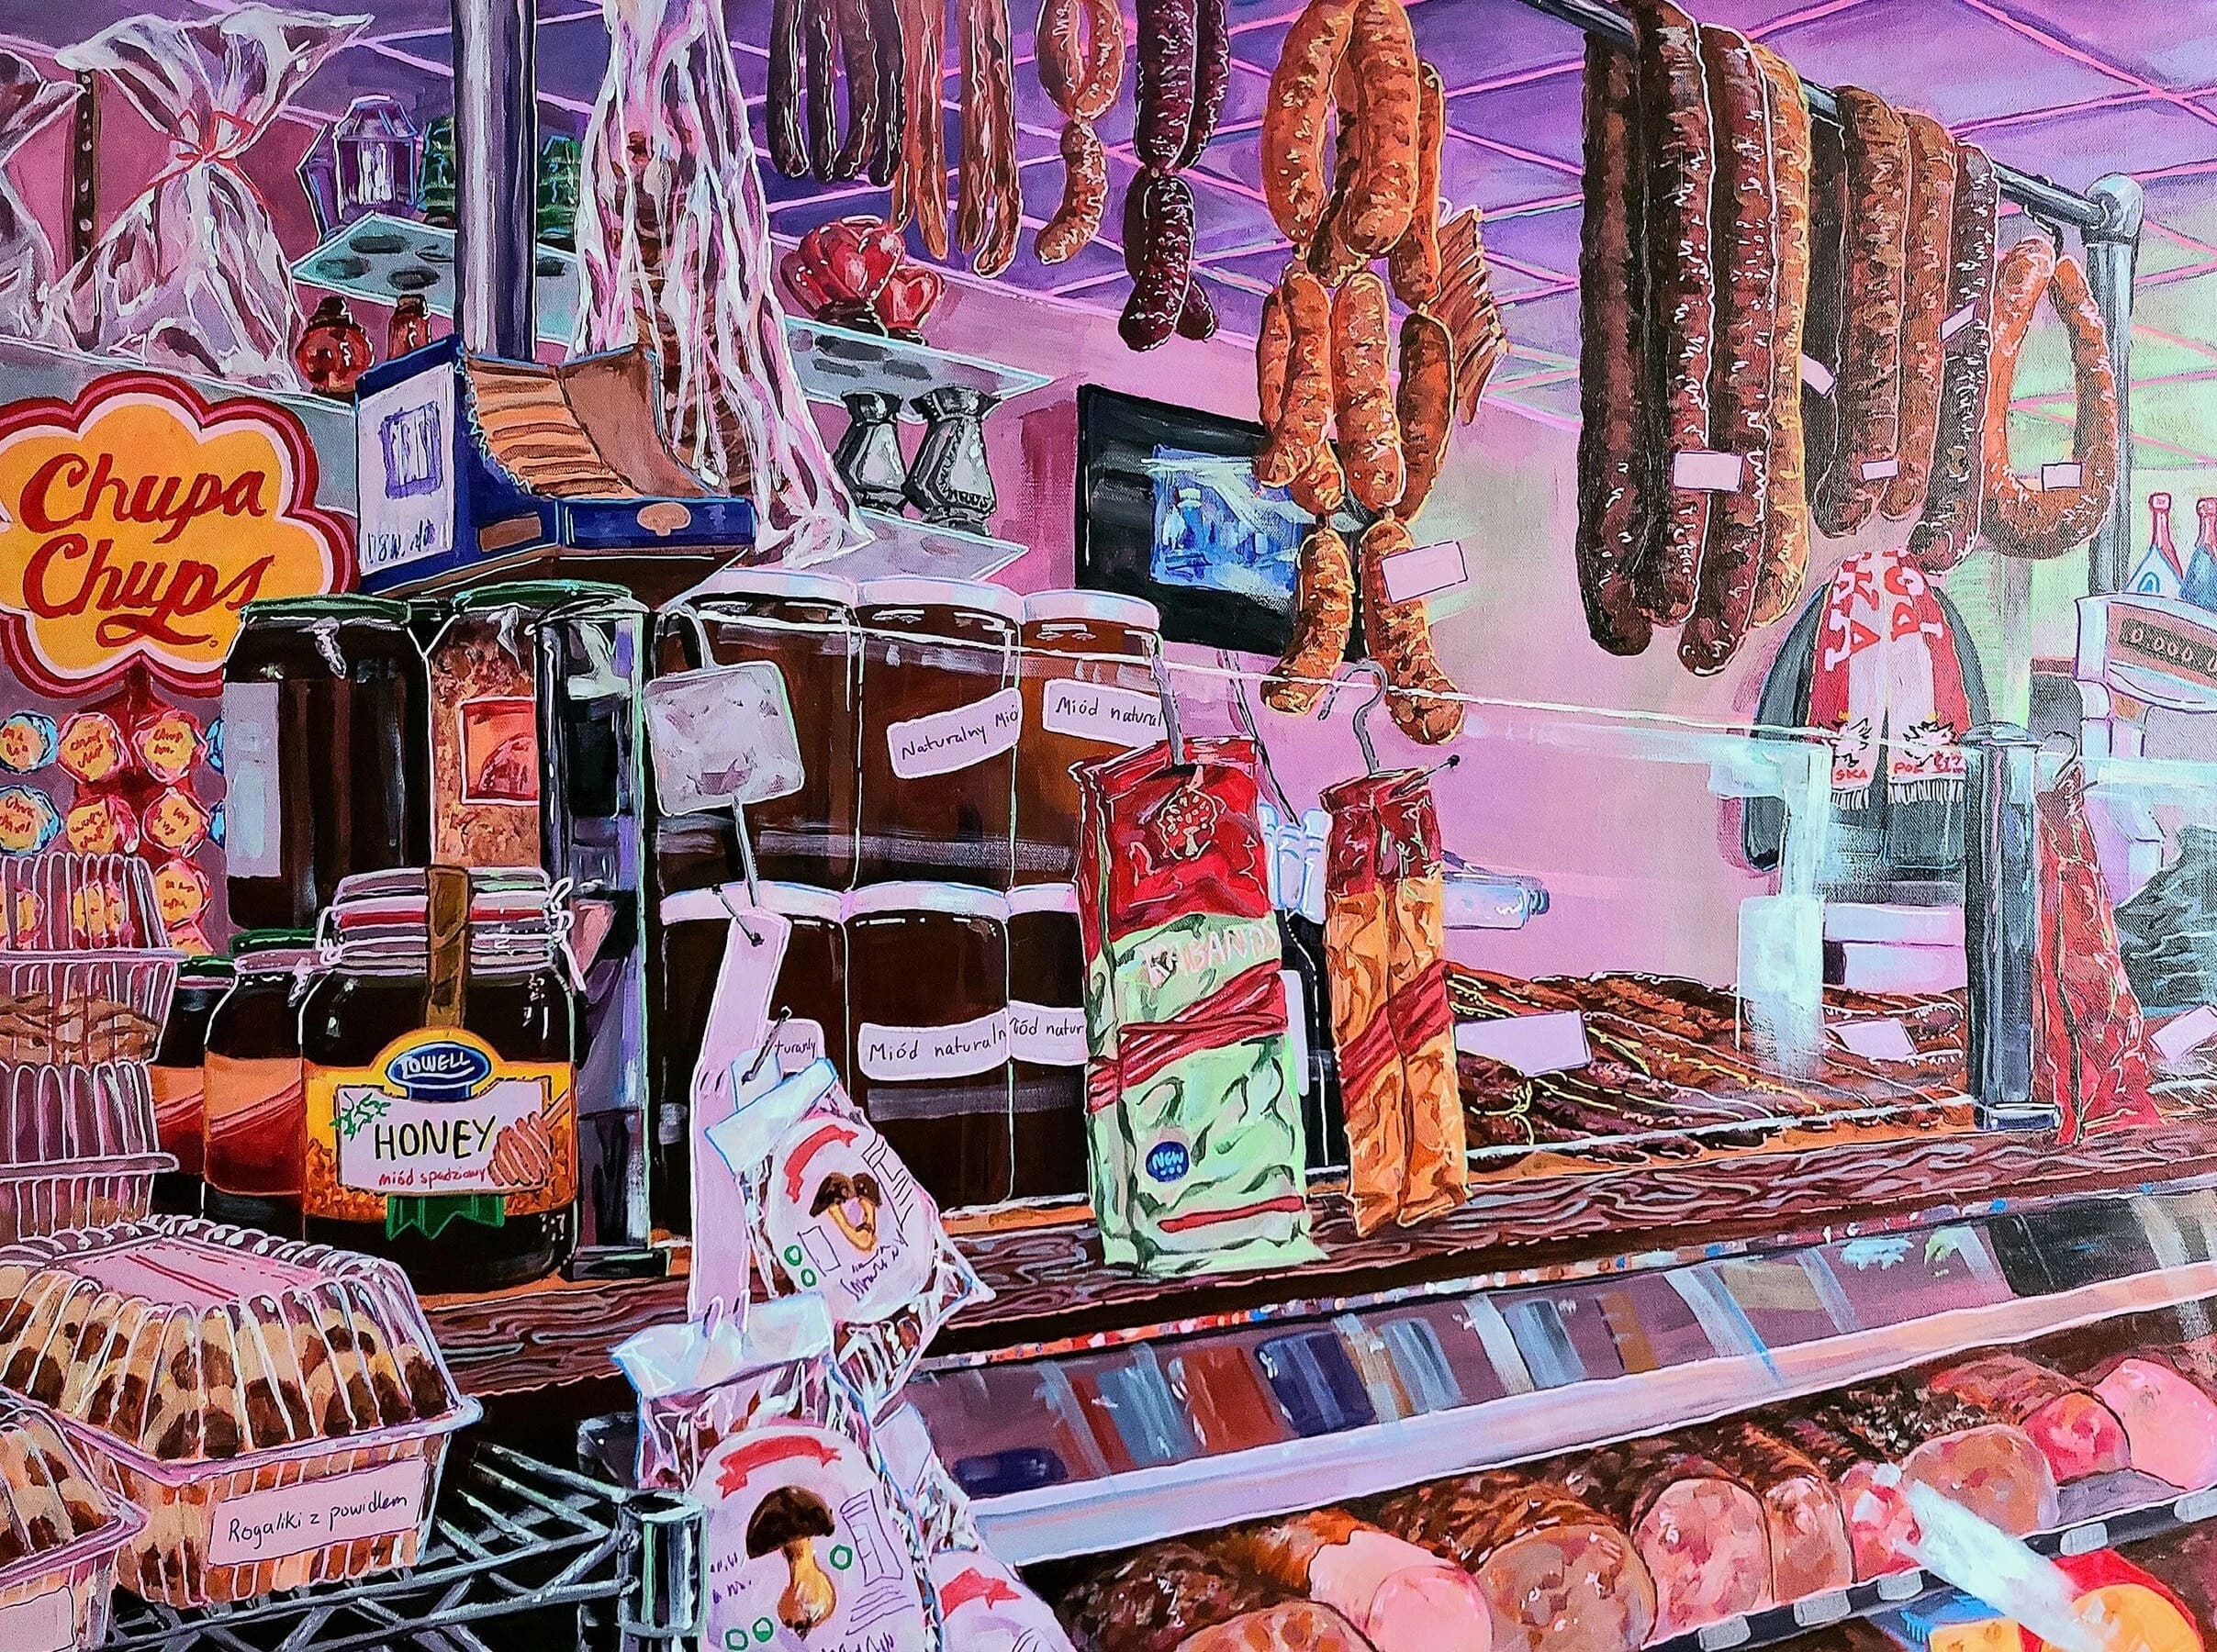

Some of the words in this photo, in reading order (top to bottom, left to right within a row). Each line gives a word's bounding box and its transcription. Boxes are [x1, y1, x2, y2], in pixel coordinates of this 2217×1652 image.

[18, 452, 267, 544] Chupa
[22, 533, 275, 647] Chups
[1055, 697, 1100, 716] Miód
[1110, 705, 1162, 728] natural
[901, 725, 989, 760] Naturalny
[868, 1042, 919, 1063] Miód
[374, 1114, 497, 1161] HONEY
[378, 1166, 414, 1187] miód
[228, 1510, 303, 1550] Rogaliki
[309, 1512, 320, 1525] z
